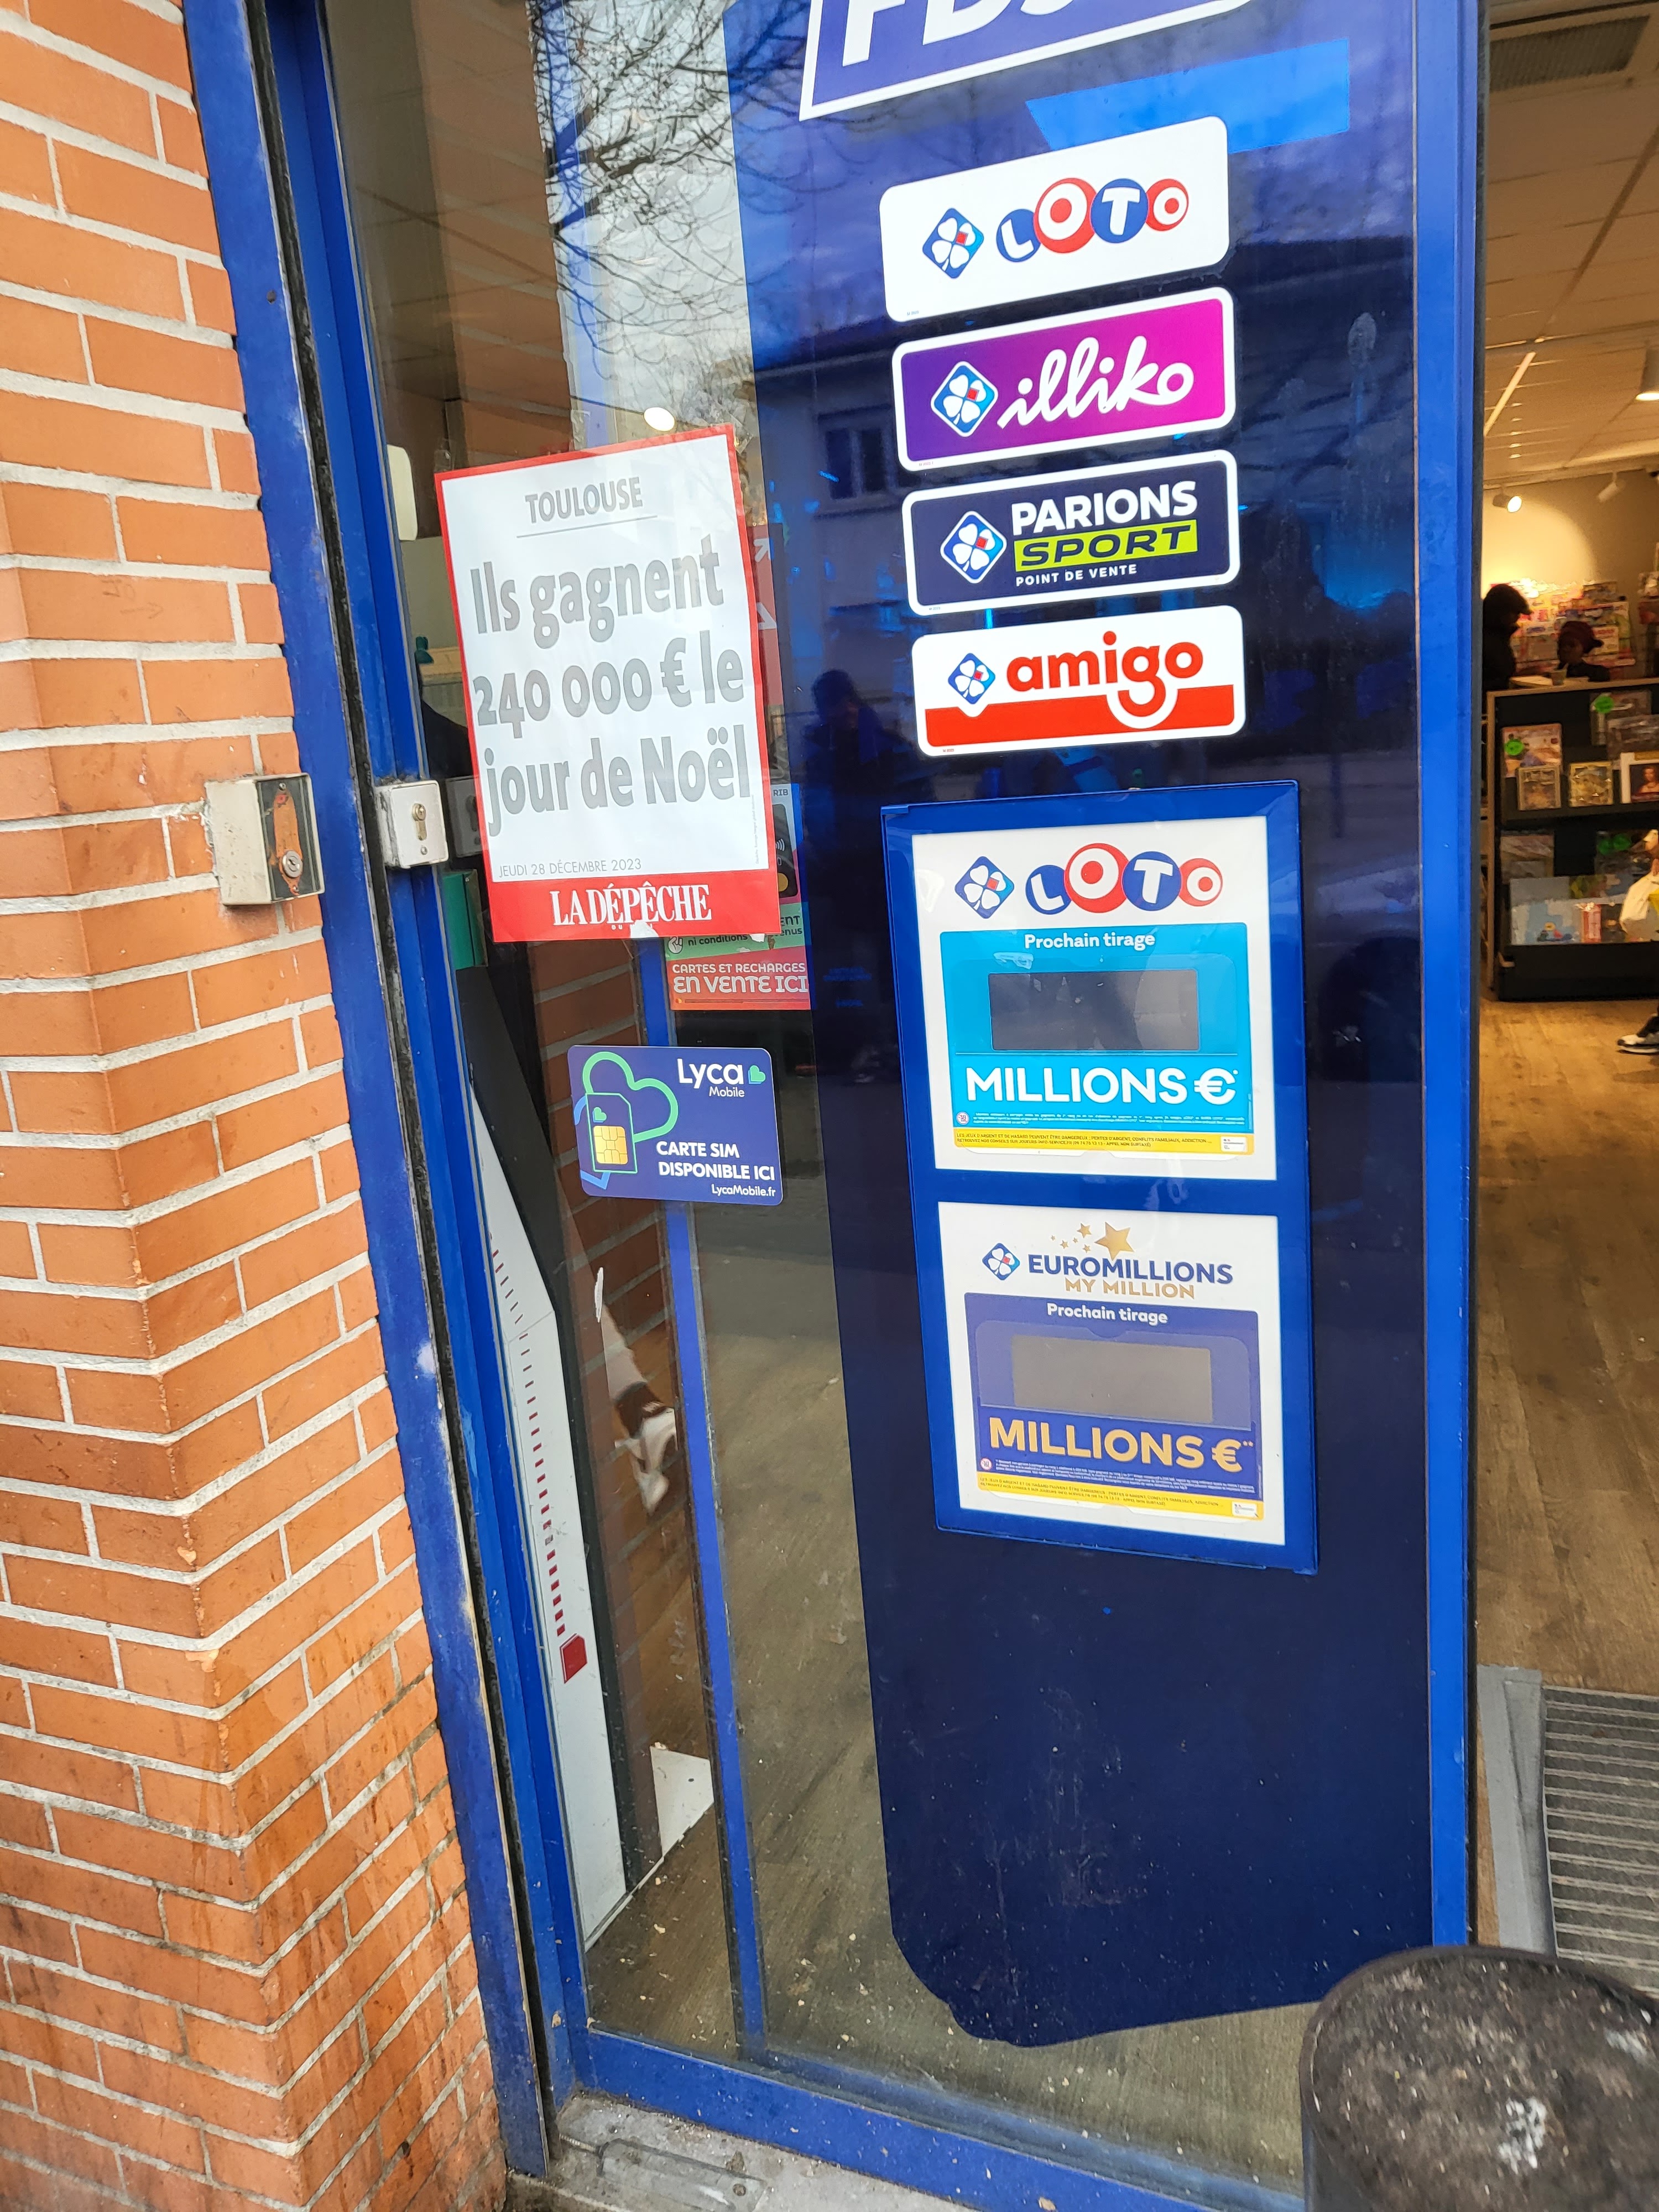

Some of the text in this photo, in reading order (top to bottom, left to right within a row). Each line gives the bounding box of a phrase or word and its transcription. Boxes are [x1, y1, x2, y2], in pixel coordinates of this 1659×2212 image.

[997, 178, 1188, 262] LOTO
[997, 336, 1194, 429] illiko
[525, 477, 643, 523] TOULOUSE
[1011, 481, 1197, 535] PARIONS
[1021, 525, 1191, 566] SPORT
[1016, 564, 1137, 586] POINT DE VENTE
[471, 562, 520, 634] Ils
[530, 534, 724, 649] gagnent
[473, 630, 744, 738] 240 000 € le
[1007, 631, 1203, 717] amigo
[484, 724, 750, 837] jour de Noël
[499, 858, 641, 878] JEUDI 28 DÉCEMBRE 2023
[1025, 843, 1222, 915] LOTO
[688, 937, 697, 946] ni
[699, 934, 748, 945] conditions
[1025, 932, 1155, 951] Prochain tirage
[672, 963, 806, 974] CARTES ET RECHARGES
[775, 976, 808, 993] ICI
[677, 1058, 744, 1088] Lyca
[966, 1067, 1188, 1104] MILLIONS
[709, 1086, 745, 1098] Mobile
[656, 1141, 740, 1158] CARTE SIM
[659, 1162, 775, 1181] DISPONIBLE ICI
[711, 1184, 776, 1197] LycaMobile.fr
[1028, 1254, 1233, 1284] EUROMILLIONS
[1065, 1278, 1194, 1299] MY MILLION
[1047, 1302, 1168, 1326] Prochain tirage
[989, 1417, 1204, 1468] MILLIONS
